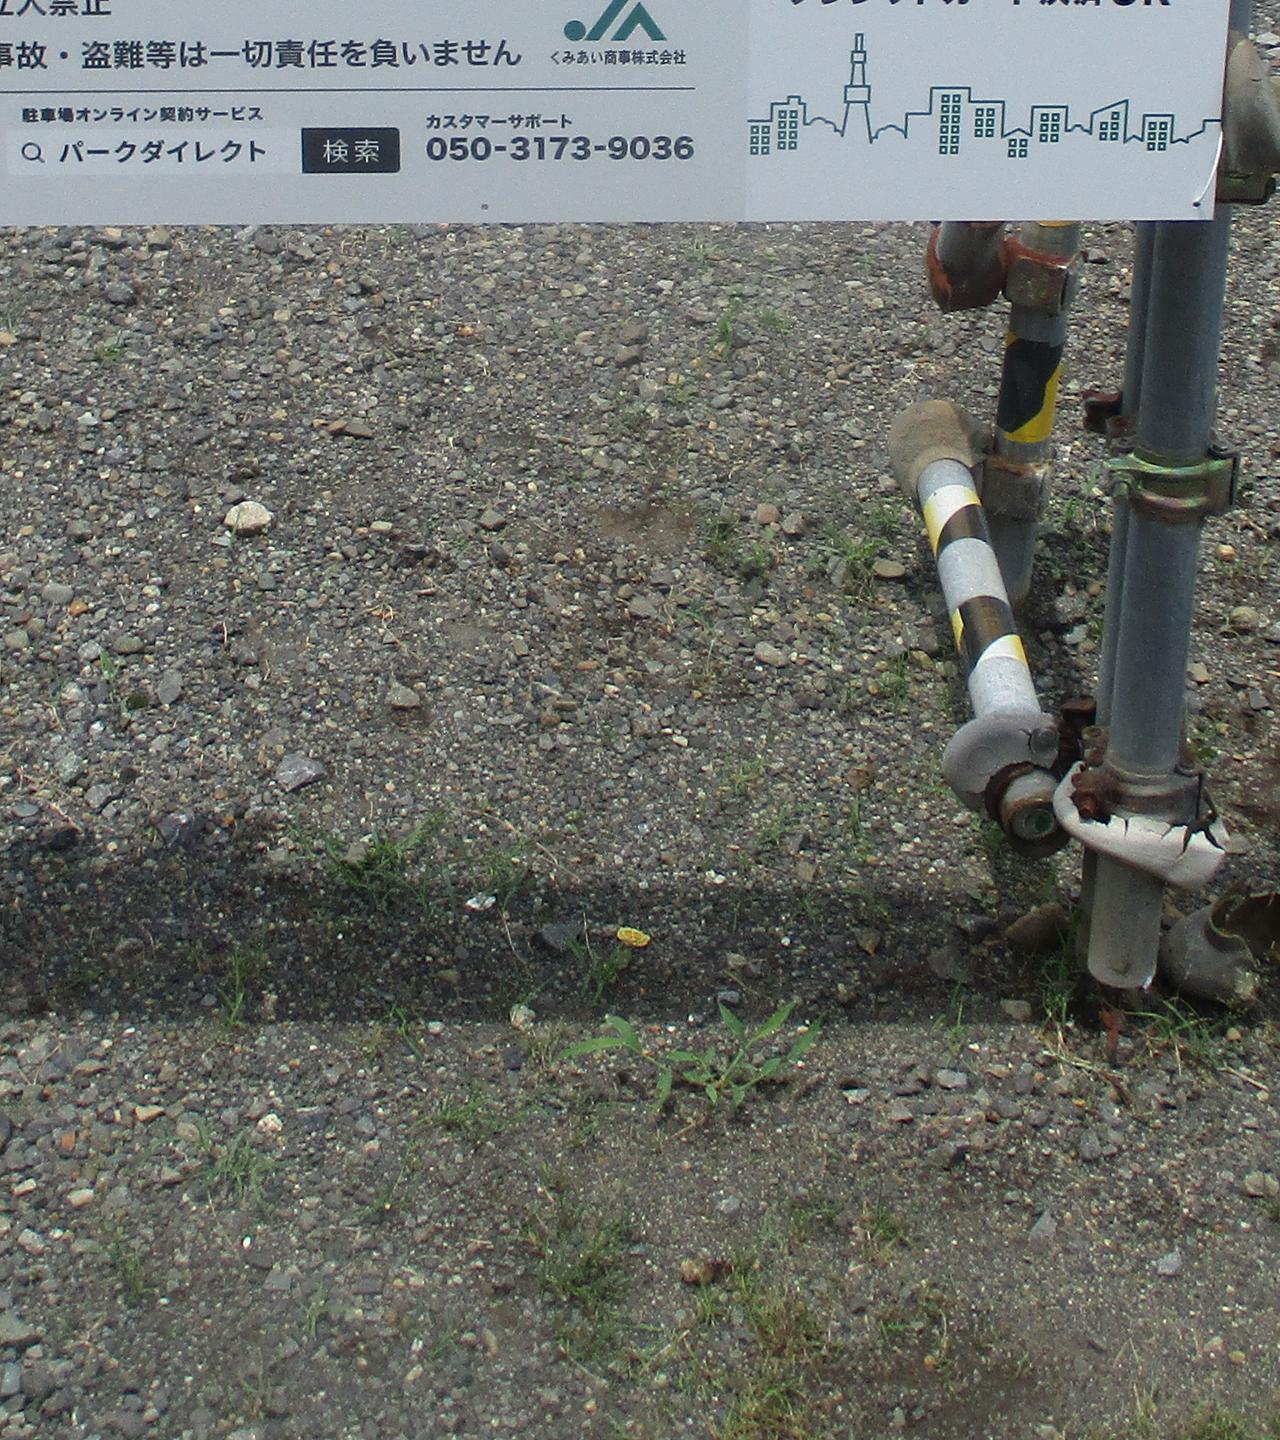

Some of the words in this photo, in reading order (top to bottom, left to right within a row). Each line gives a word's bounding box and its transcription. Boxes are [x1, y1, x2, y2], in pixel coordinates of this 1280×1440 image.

[549, 49, 687, 66] くみあい商事株式会社
[21, 106, 265, 124] 駐車場オンライン契約サービス
[425, 113, 573, 130] カスタマーサポート
[58, 139, 267, 163] パークダイレクト
[322, 138, 381, 163] 検索
[425, 135, 696, 162] 050-3173-9036
